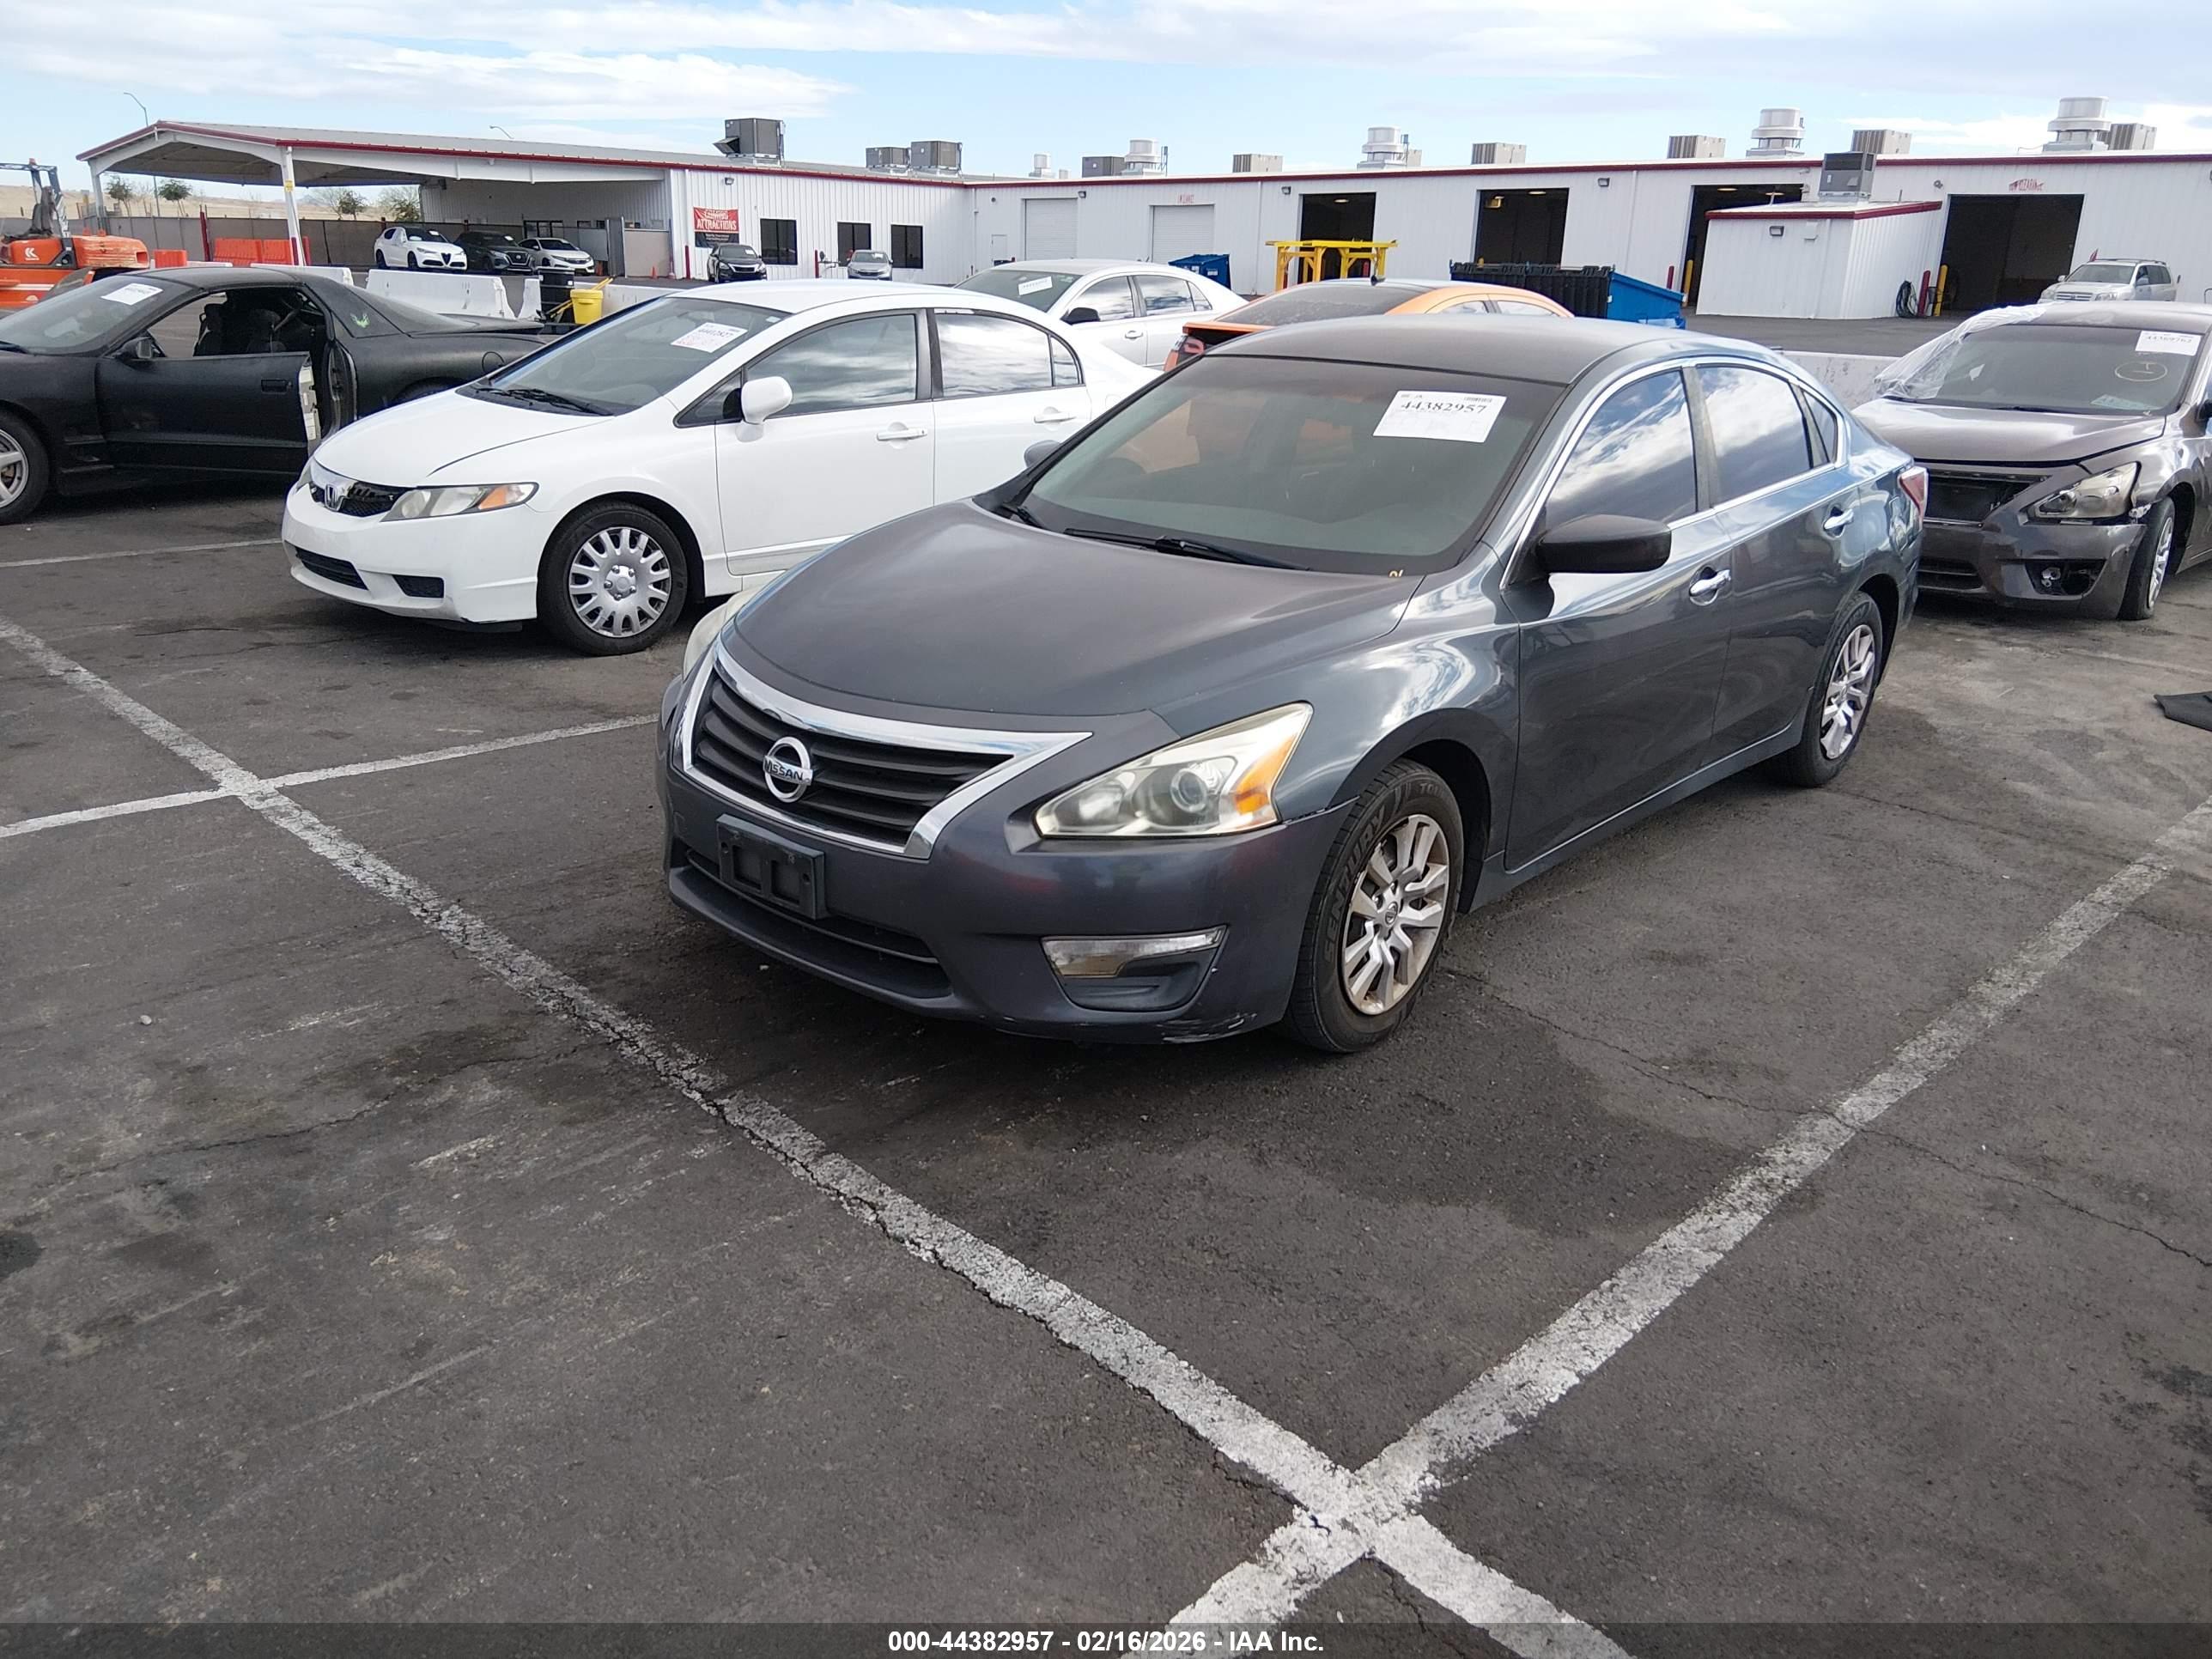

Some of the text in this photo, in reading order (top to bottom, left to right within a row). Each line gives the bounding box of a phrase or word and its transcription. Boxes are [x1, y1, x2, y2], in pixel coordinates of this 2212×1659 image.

[696, 218, 737, 231] ATTRACTIONS
[1401, 401, 1487, 414] 44382957
[764, 759, 804, 781] NISSAN
